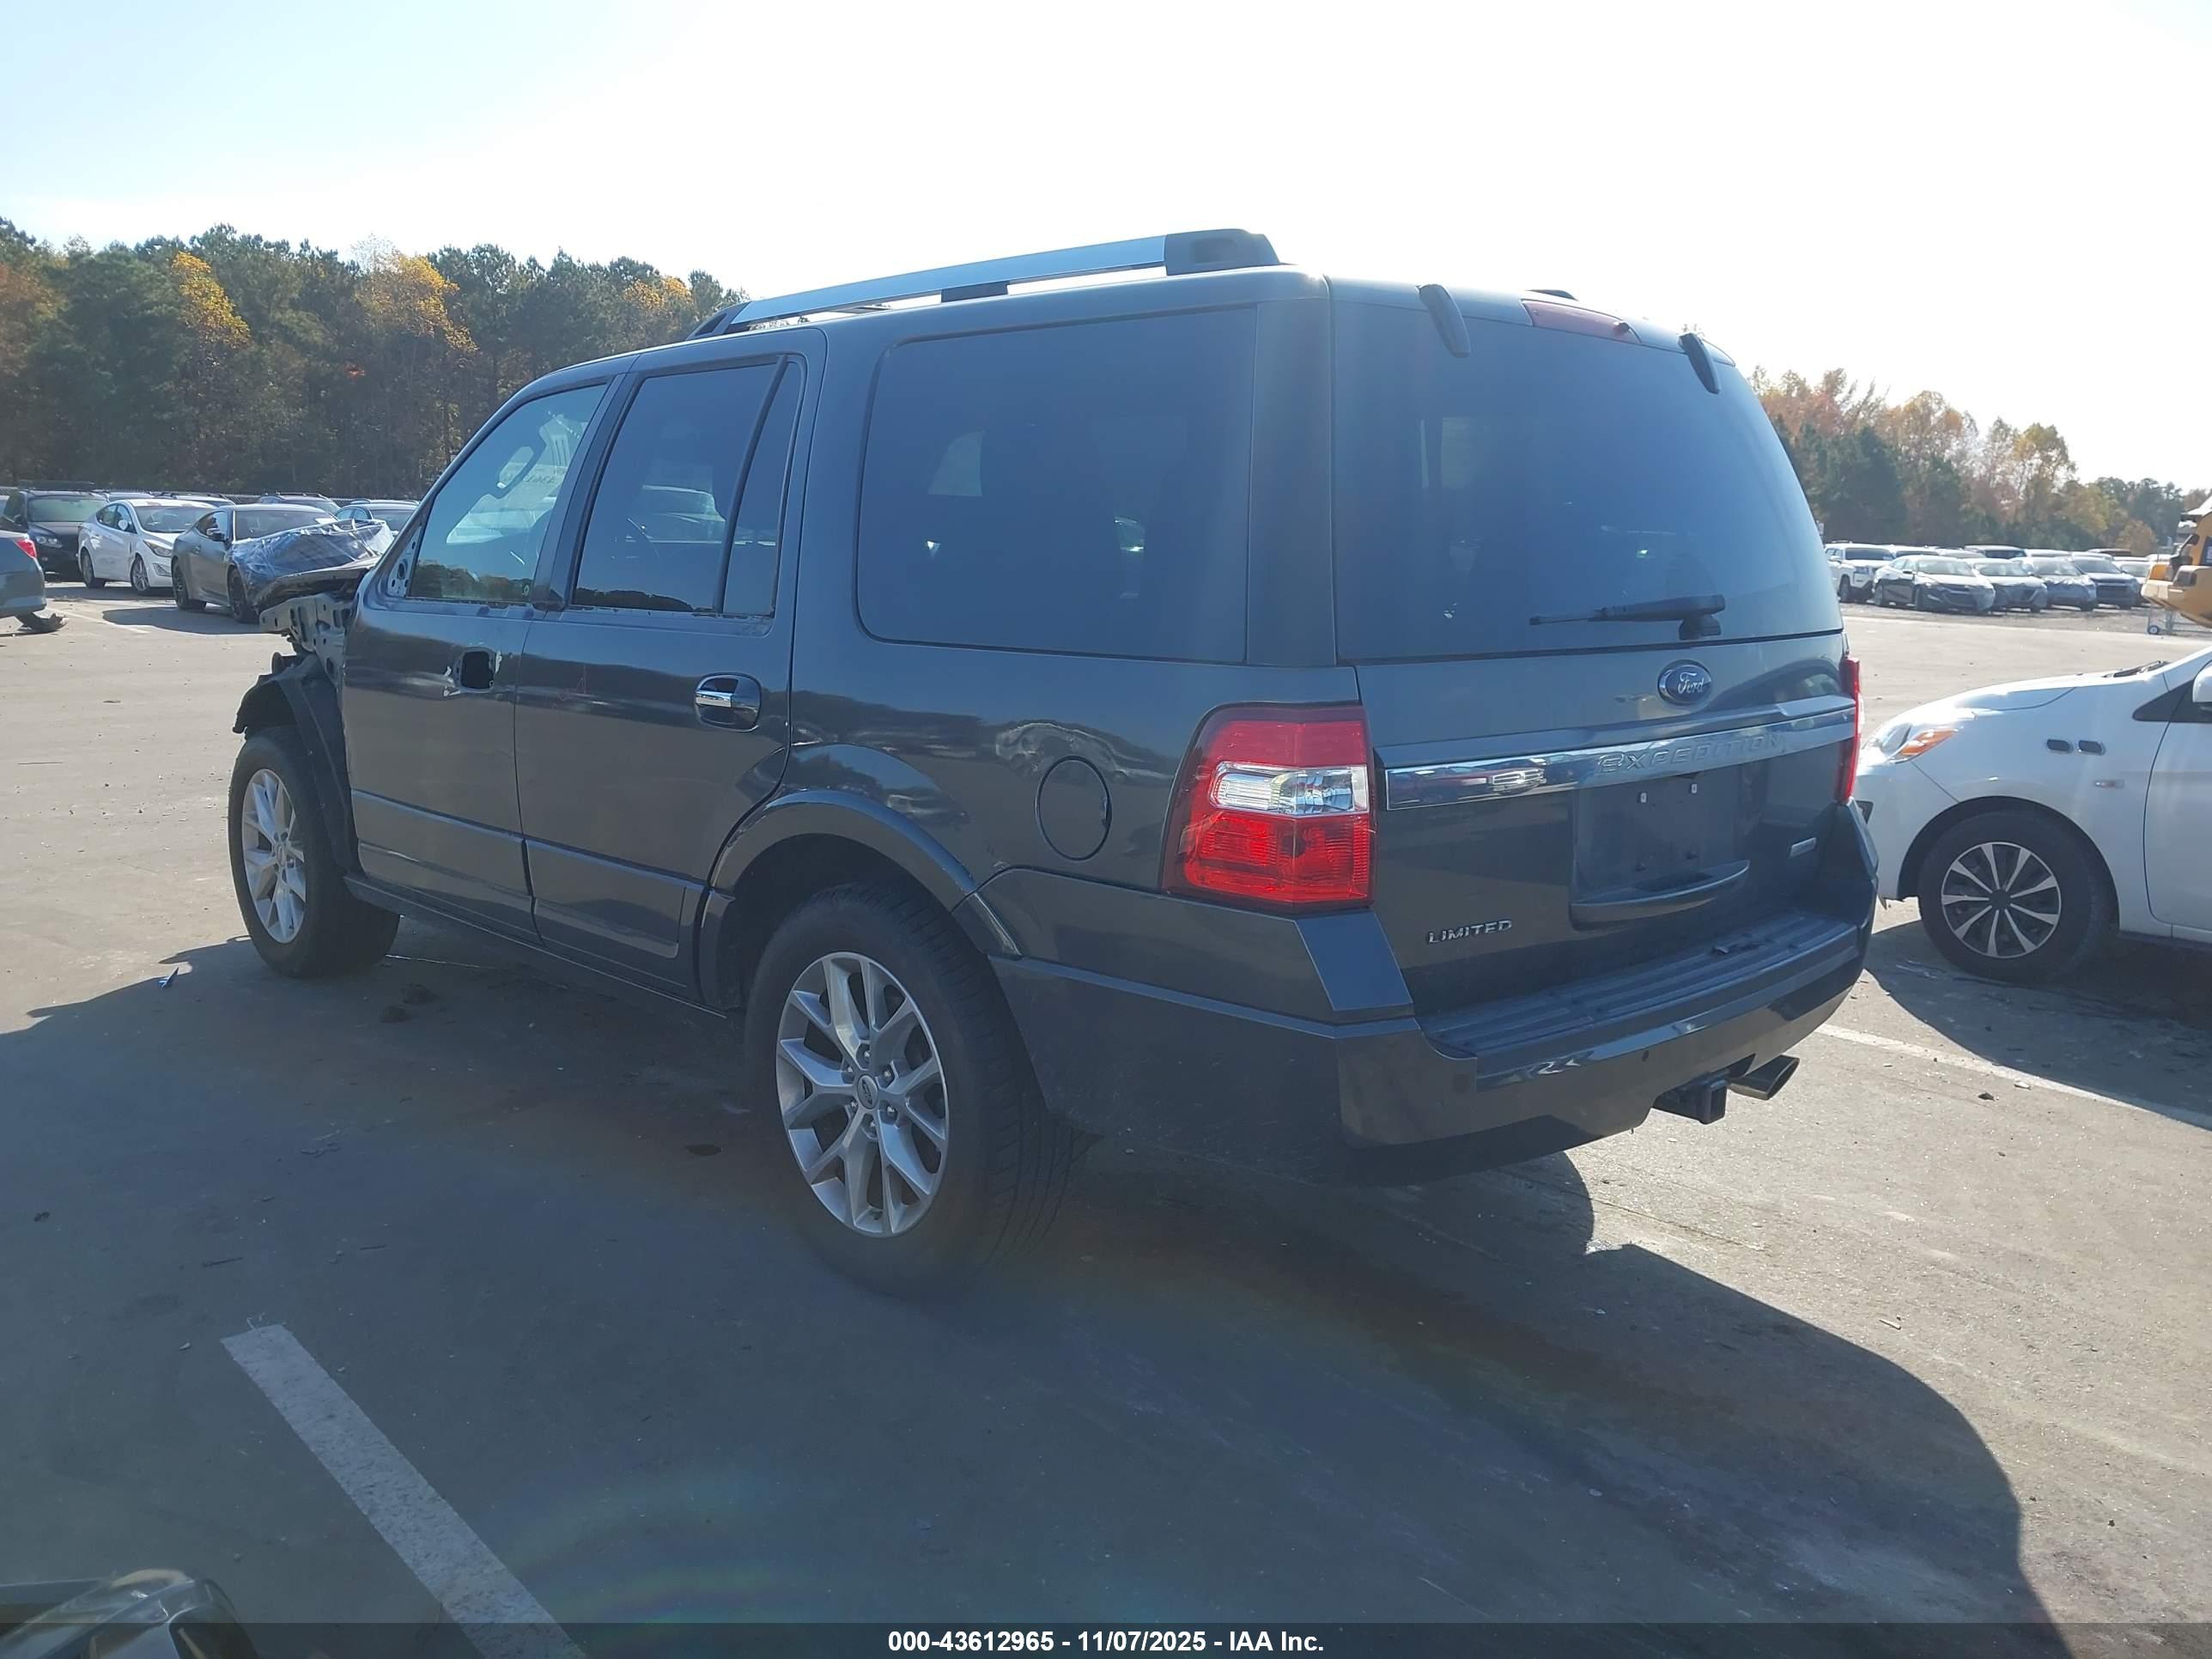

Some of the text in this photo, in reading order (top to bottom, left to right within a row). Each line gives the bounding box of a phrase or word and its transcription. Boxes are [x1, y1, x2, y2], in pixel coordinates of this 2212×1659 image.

[1677, 672, 1705, 695] Ford
[1598, 734, 1783, 773] EXPEDITION
[1428, 920, 1512, 944] LIMITED
